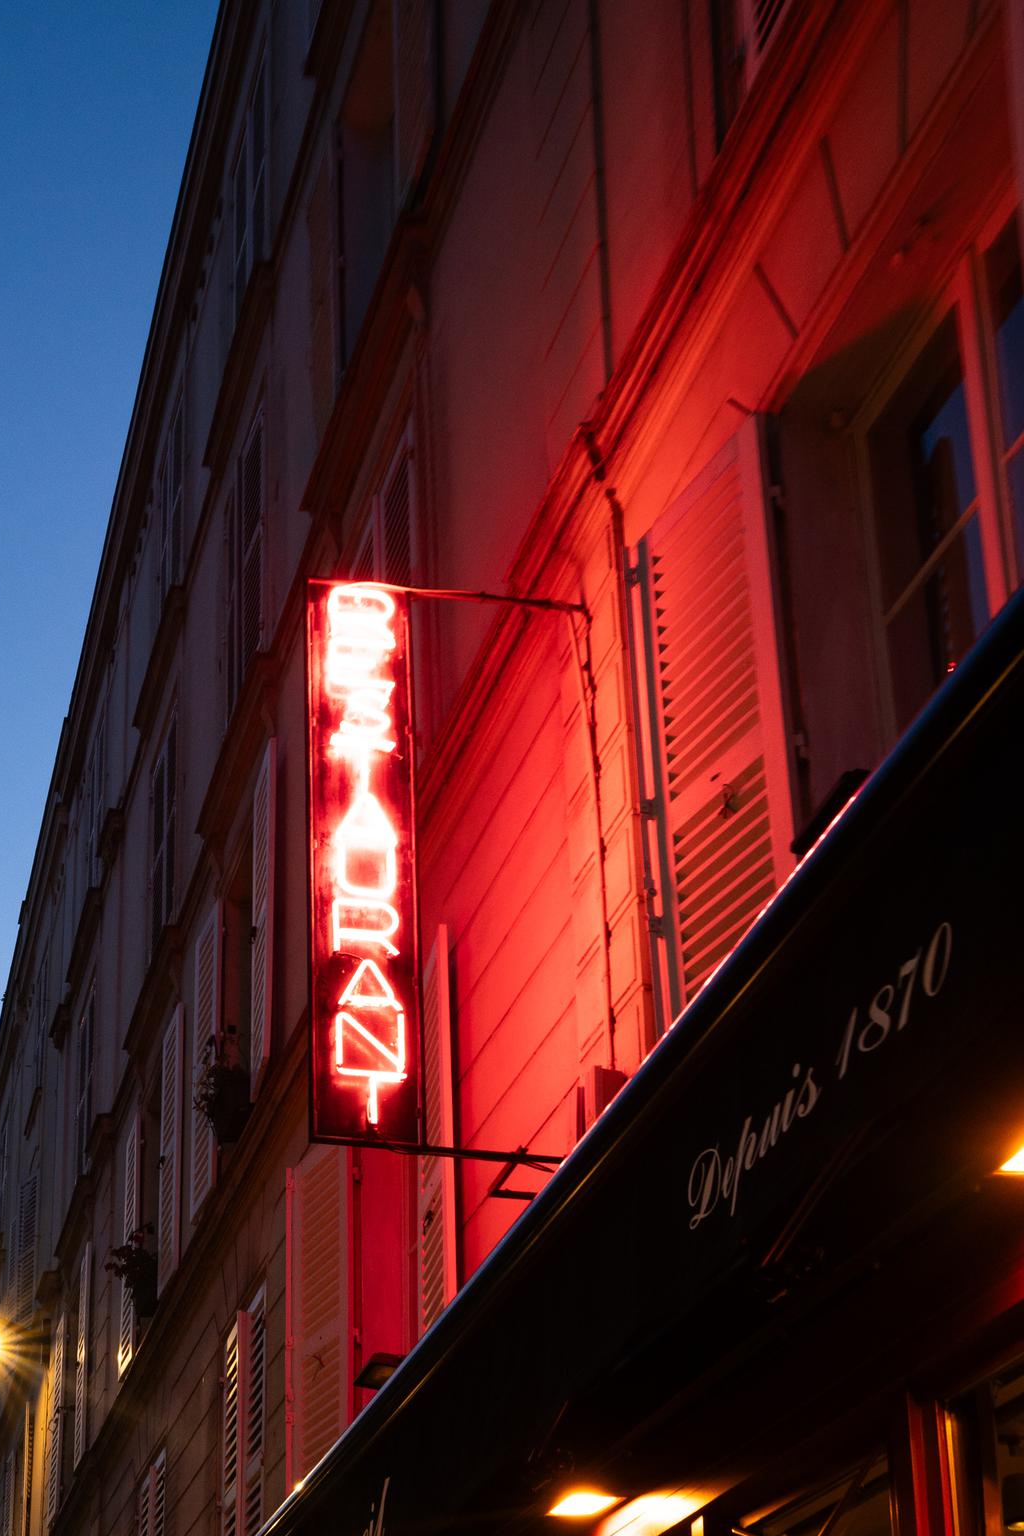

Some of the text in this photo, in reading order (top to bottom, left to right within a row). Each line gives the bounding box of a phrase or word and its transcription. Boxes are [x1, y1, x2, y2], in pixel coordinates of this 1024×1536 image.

[326, 583, 408, 1126] RESTAURANT
[688, 921, 952, 1230] Depuis 1870
